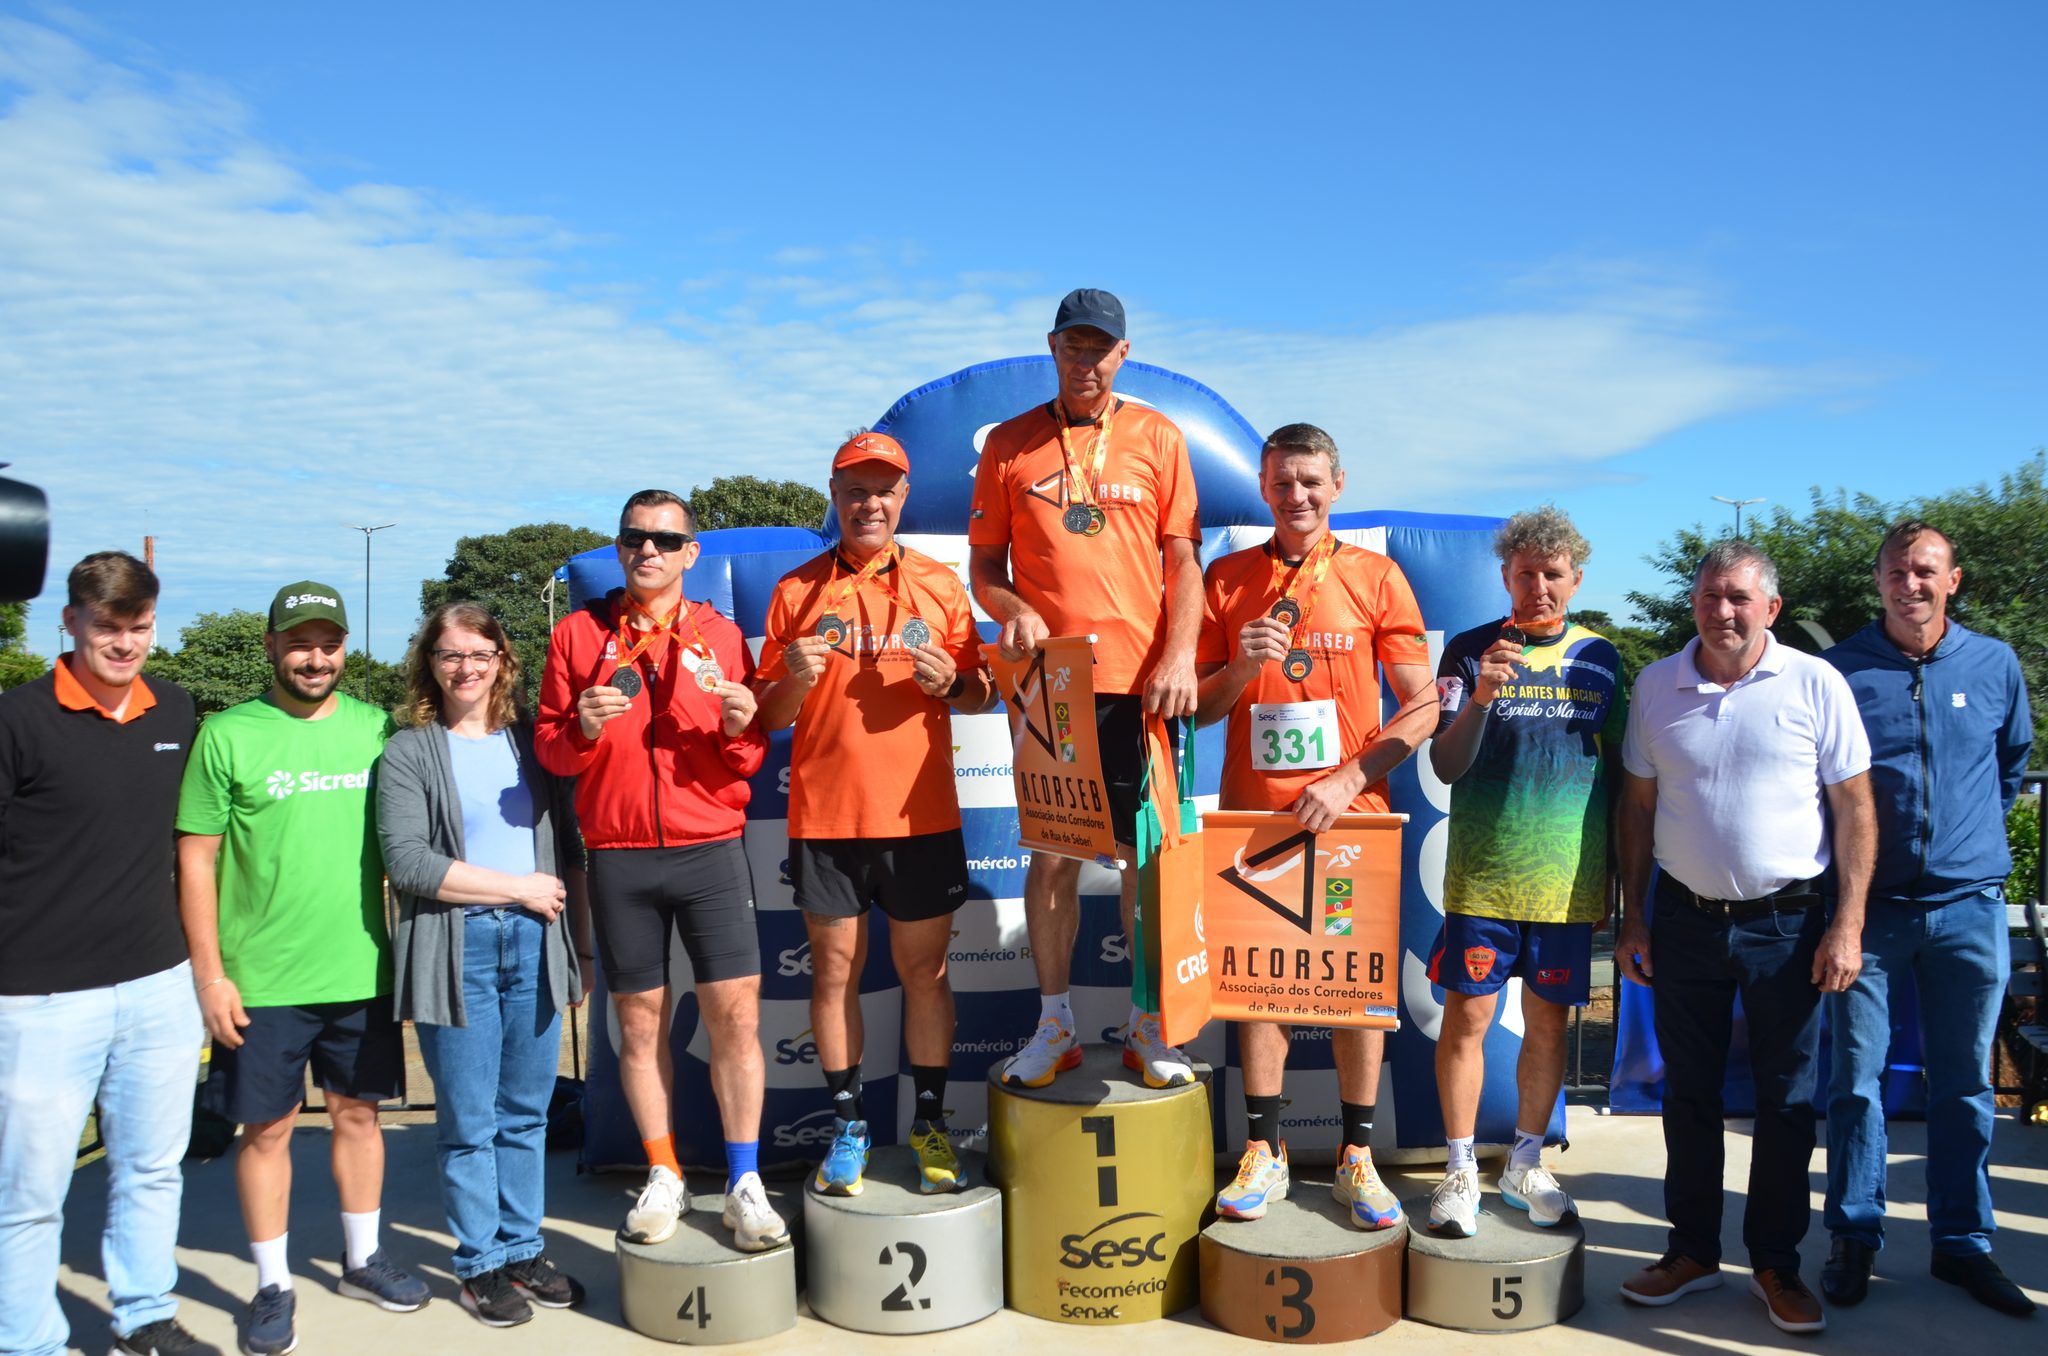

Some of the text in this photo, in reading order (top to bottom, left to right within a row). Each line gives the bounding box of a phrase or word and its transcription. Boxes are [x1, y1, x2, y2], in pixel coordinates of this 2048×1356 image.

[1519, 685, 1553, 699] ARTES
[1556, 687, 1602, 704] MARCIAIS
[1496, 699, 1543, 721] Espírito
[1262, 727, 1325, 765] 331
[1021, 772, 1102, 812] ACORSEB
[1025, 806, 1105, 830] Associação dos Corredores
[1041, 828, 1049, 839] de
[1049, 830, 1061, 841] Rua
[1062, 833, 1071, 844] de
[966, 855, 1017, 870] mércio
[949, 948, 1016, 962] comércio
[1221, 946, 1384, 984] ACORSEB
[1219, 981, 1383, 1000] Associação dos Corredores
[1248, 1001, 1352, 1017] de Rua de Seberi
[951, 1039, 1014, 1053] omércio
[773, 1124, 835, 1147] Ses
[1081, 1115, 1119, 1207] 1
[1059, 1230, 1167, 1269] Sesc
[879, 1241, 931, 1312] 2
[1059, 1277, 1167, 1299] Fecomércio
[676, 1286, 712, 1329] 4
[1264, 1266, 1316, 1339] 3
[1491, 1276, 1523, 1320] 5
[1060, 1303, 1120, 1320] Senac
